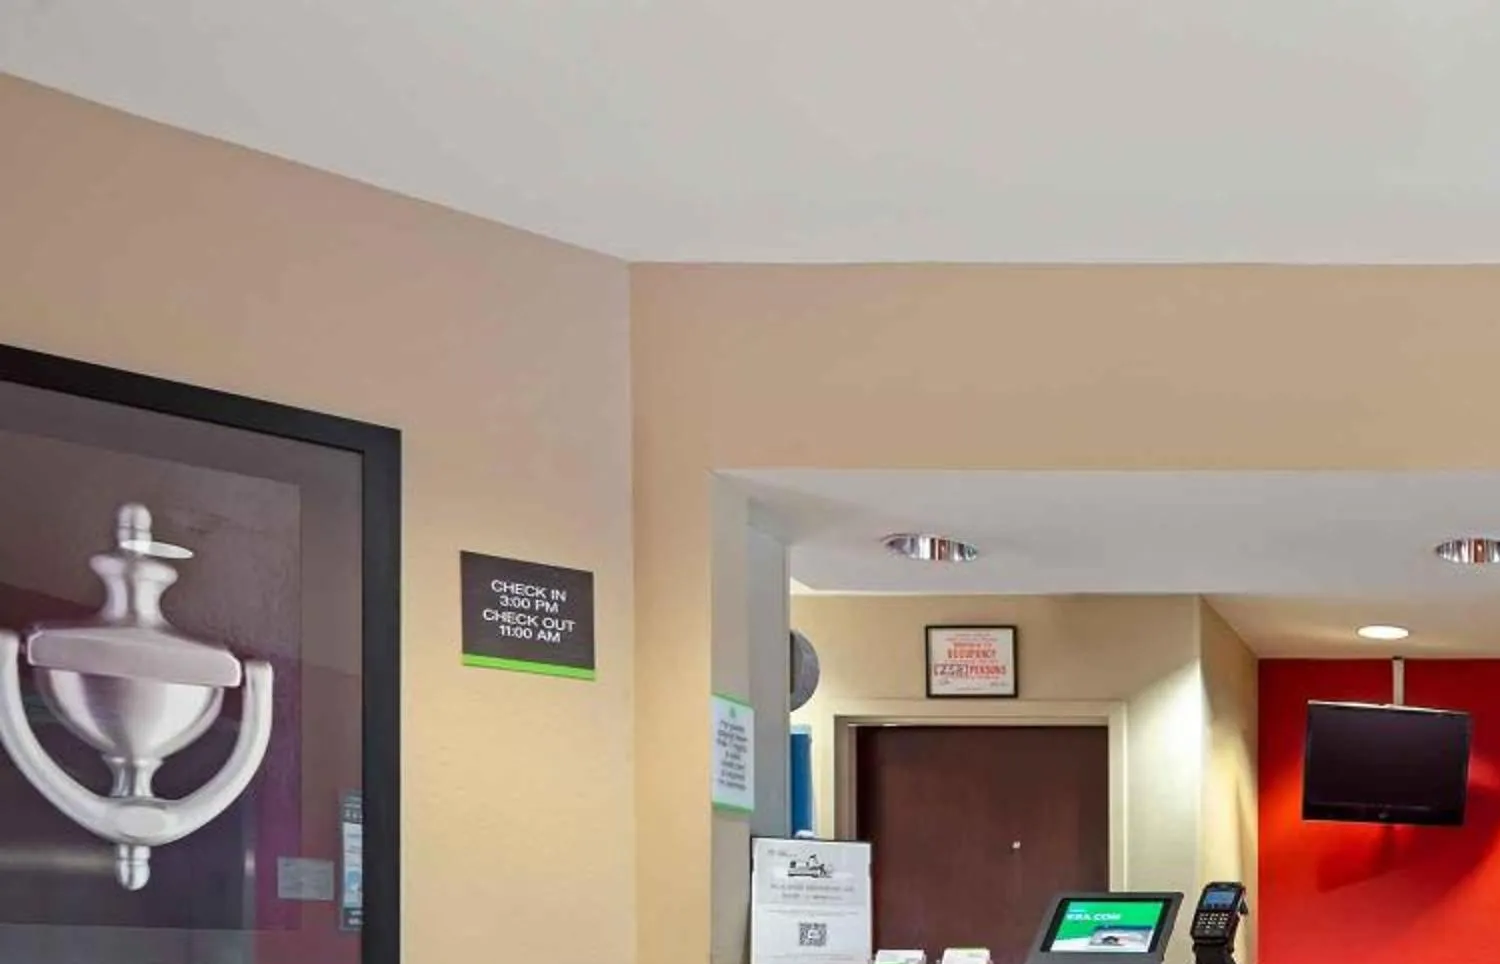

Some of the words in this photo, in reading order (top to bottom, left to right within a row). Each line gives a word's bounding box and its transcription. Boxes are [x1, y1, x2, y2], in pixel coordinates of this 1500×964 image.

[491, 579, 547, 599] CHECK
[551, 589, 567, 602] IN
[500, 595, 530, 609] 3:00
[535, 599, 559, 613] PM
[483, 608, 539, 627] CHECK
[542, 617, 576, 632] OUT
[499, 625, 533, 639] 11:00
[537, 629, 561, 643] AM
